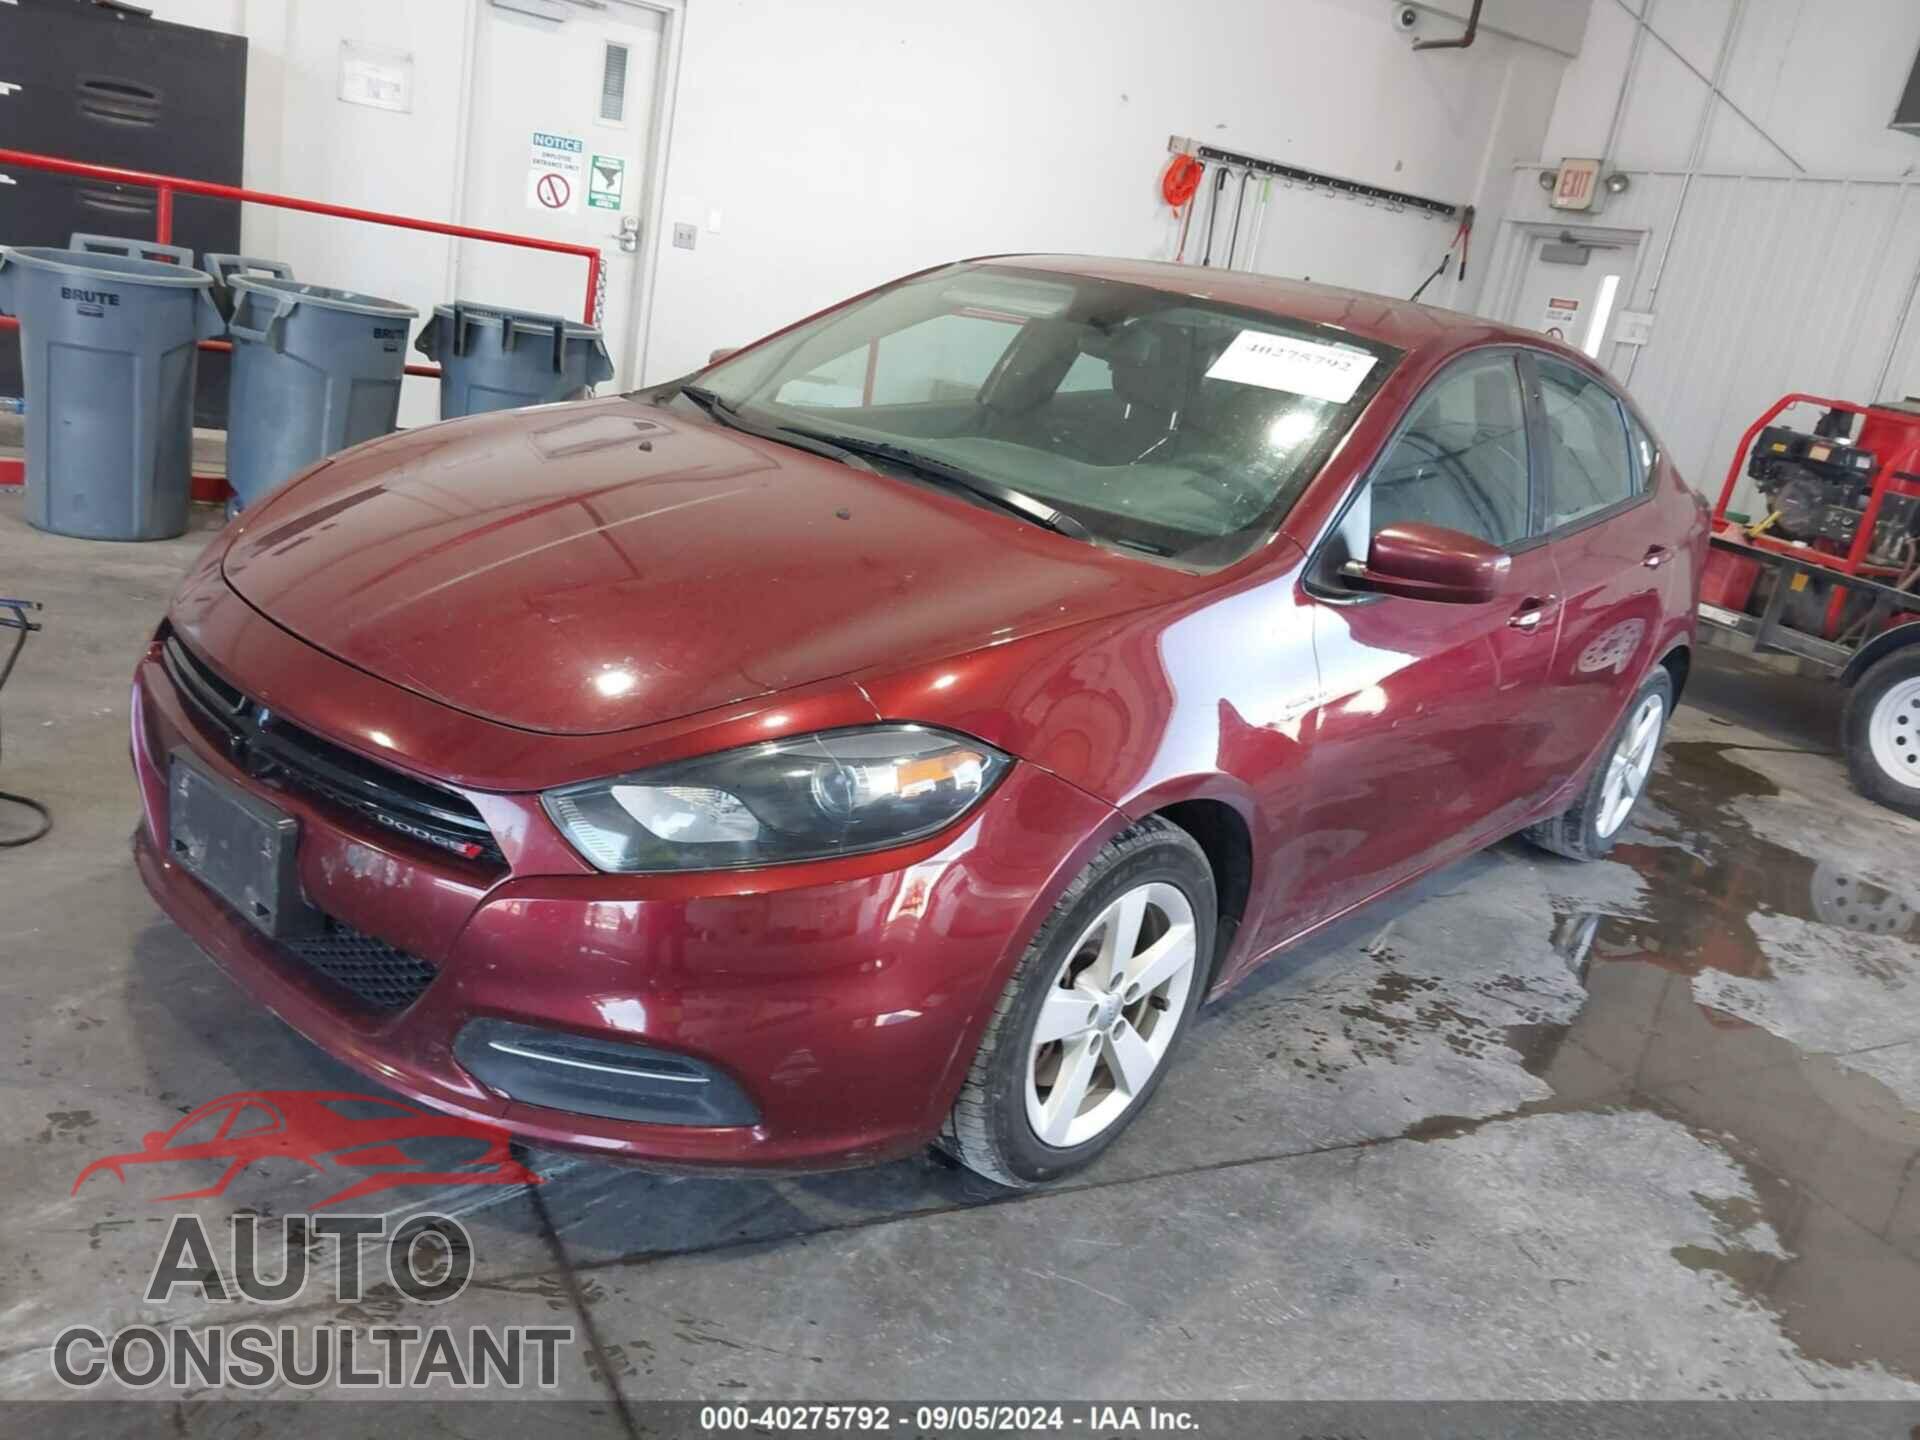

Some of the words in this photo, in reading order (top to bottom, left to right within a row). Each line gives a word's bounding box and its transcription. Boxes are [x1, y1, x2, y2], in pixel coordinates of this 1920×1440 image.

[534, 133, 582, 152] NOTICE
[1560, 169, 1593, 199] EXIT
[61, 287, 120, 306] BRUTE
[376, 813, 466, 857] DODGE
